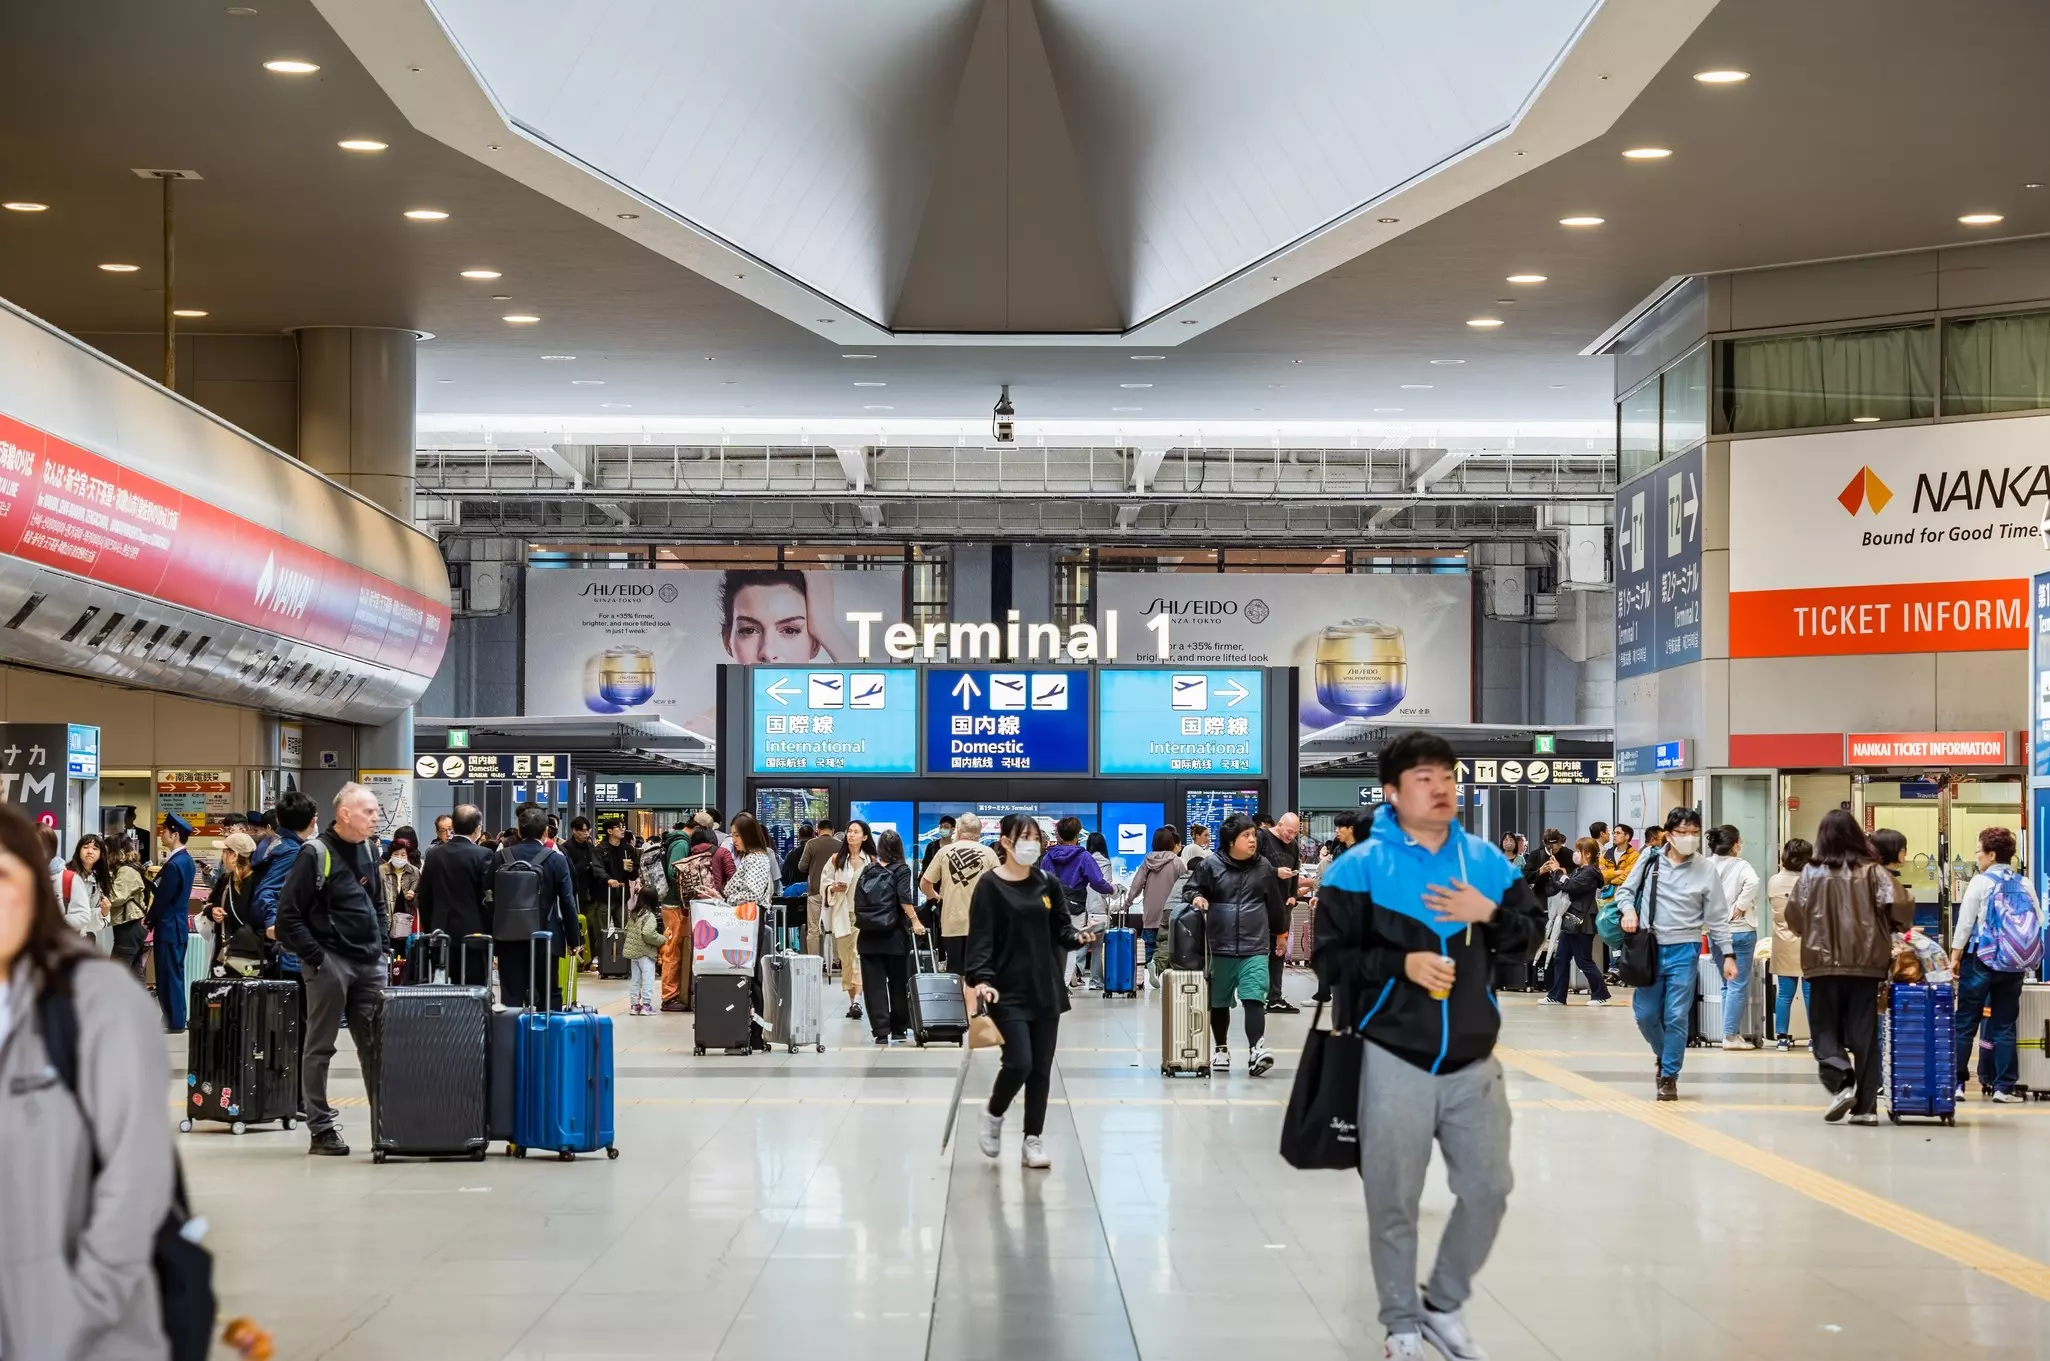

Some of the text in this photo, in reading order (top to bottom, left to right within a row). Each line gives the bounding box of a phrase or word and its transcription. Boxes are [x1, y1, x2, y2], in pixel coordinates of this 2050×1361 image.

[1669, 494, 1680, 537] T2
[1633, 511, 1643, 554] T1
[1862, 528, 1915, 546] Bound
[1920, 527, 1945, 543] for
[1949, 524, 1993, 541] Good
[578, 583, 654, 596] SHISEIDO
[1661, 562, 1699, 604] 第2ターミナル
[1139, 598, 1238, 615] SHISEIDO
[1618, 580, 1651, 619] 第1ターミナル
[634, 612, 655, 620] firmer,
[1674, 600, 1699, 628] Terminal 2
[1794, 604, 1891, 636] TICKET
[582, 620, 609, 628] brighter,
[846, 609, 1170, 659] Terminal 1
[1618, 620, 1634, 646] Terminal
[1187, 642, 1212, 651] +35%
[1214, 642, 1244, 651] firmer,
[1178, 653, 1195, 661] and
[1223, 653, 1246, 661] lifted
[1249, 653, 1267, 661] look
[766, 714, 834, 734] 国際線
[952, 715, 1020, 735] 国内線
[1181, 716, 1249, 736] 国際線
[766, 739, 865, 753] International
[952, 739, 1024, 753] Domestic
[1150, 740, 1250, 754] International
[1853, 741, 2001, 757] NANKAI TICKET INFORMATION
[468, 756, 497, 764] 国内線
[765, 757, 845, 768] 国际航线 국제선
[952, 757, 1030, 768] 国内航线 국내선
[1171, 759, 1249, 770] 国际航线 국제선
[1553, 761, 1581, 770] 国内線
[175, 772, 213, 782] 南海電鉄
[1477, 766, 1494, 777] T1
[1553, 770, 1583, 778] Domestic
